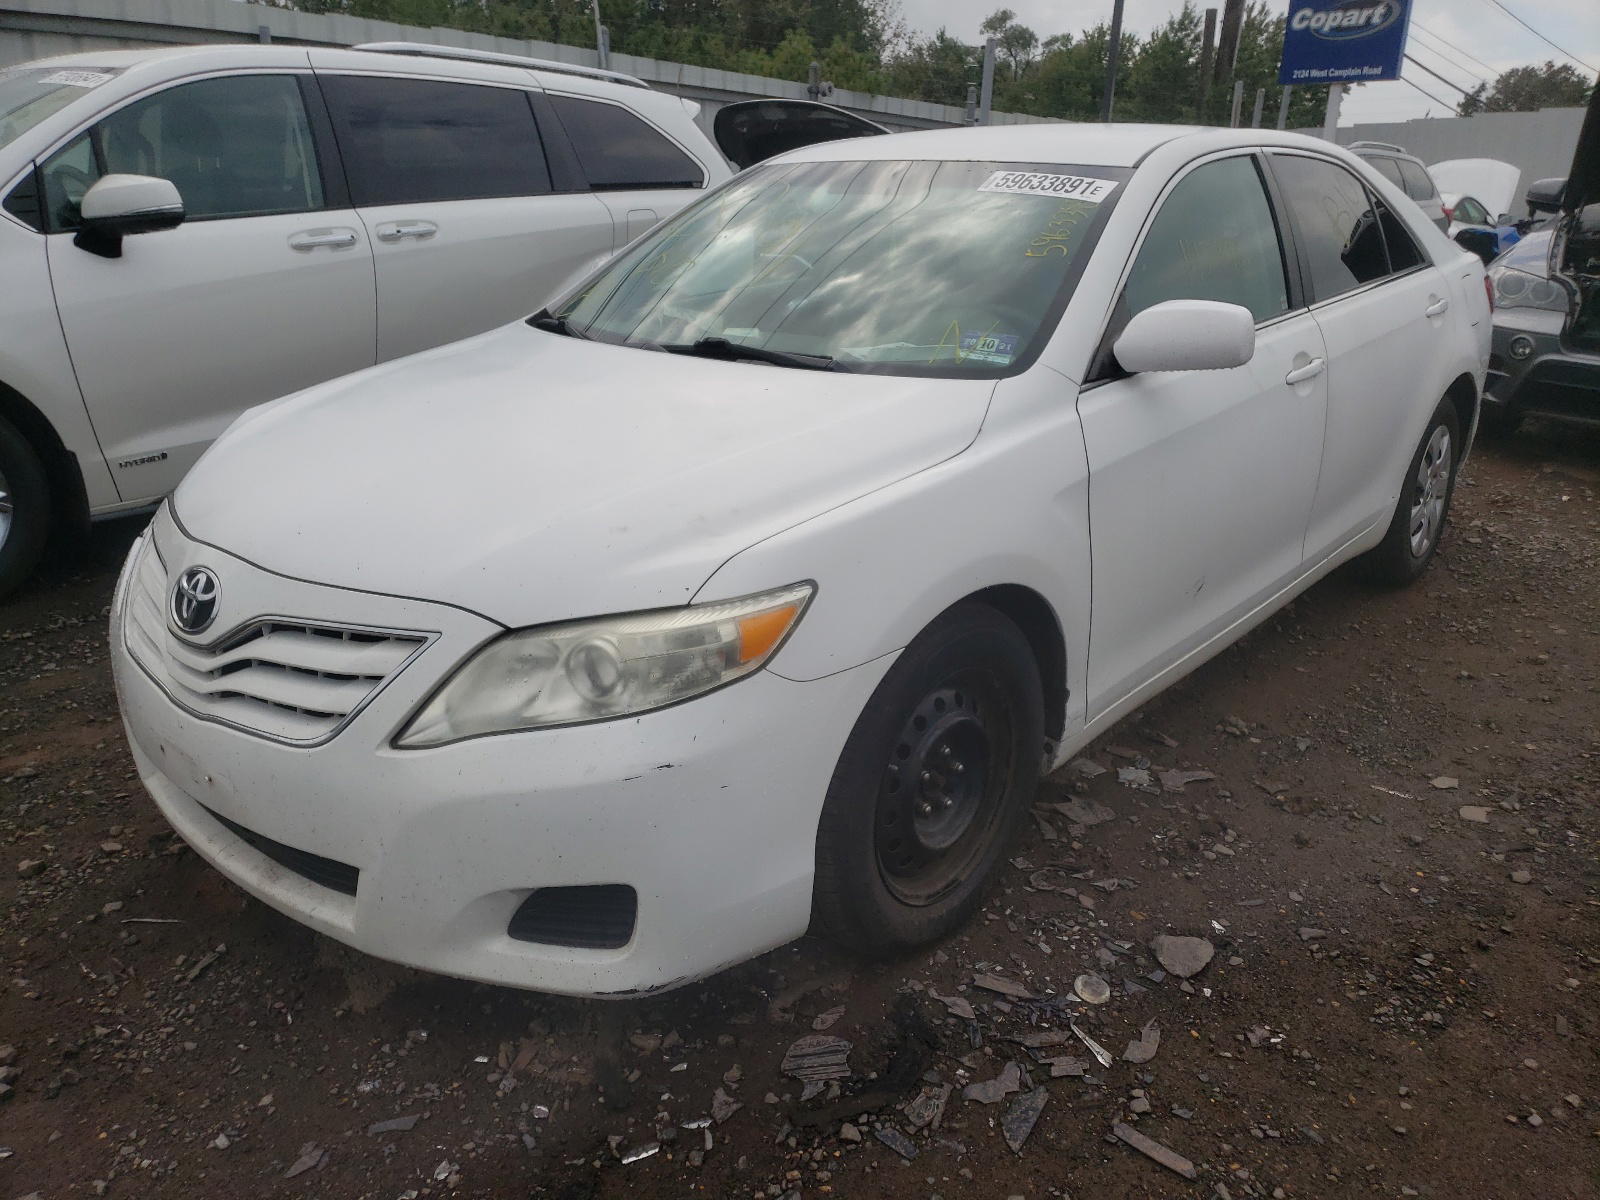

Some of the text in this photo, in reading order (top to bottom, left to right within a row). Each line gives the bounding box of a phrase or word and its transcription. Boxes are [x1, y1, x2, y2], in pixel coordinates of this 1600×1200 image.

[1291, 4, 1388, 32] Copart
[1310, 69, 1328, 78] West
[1363, 65, 1382, 75] Road
[980, 339, 996, 350] 10
[119, 455, 161, 468] HYBRID
